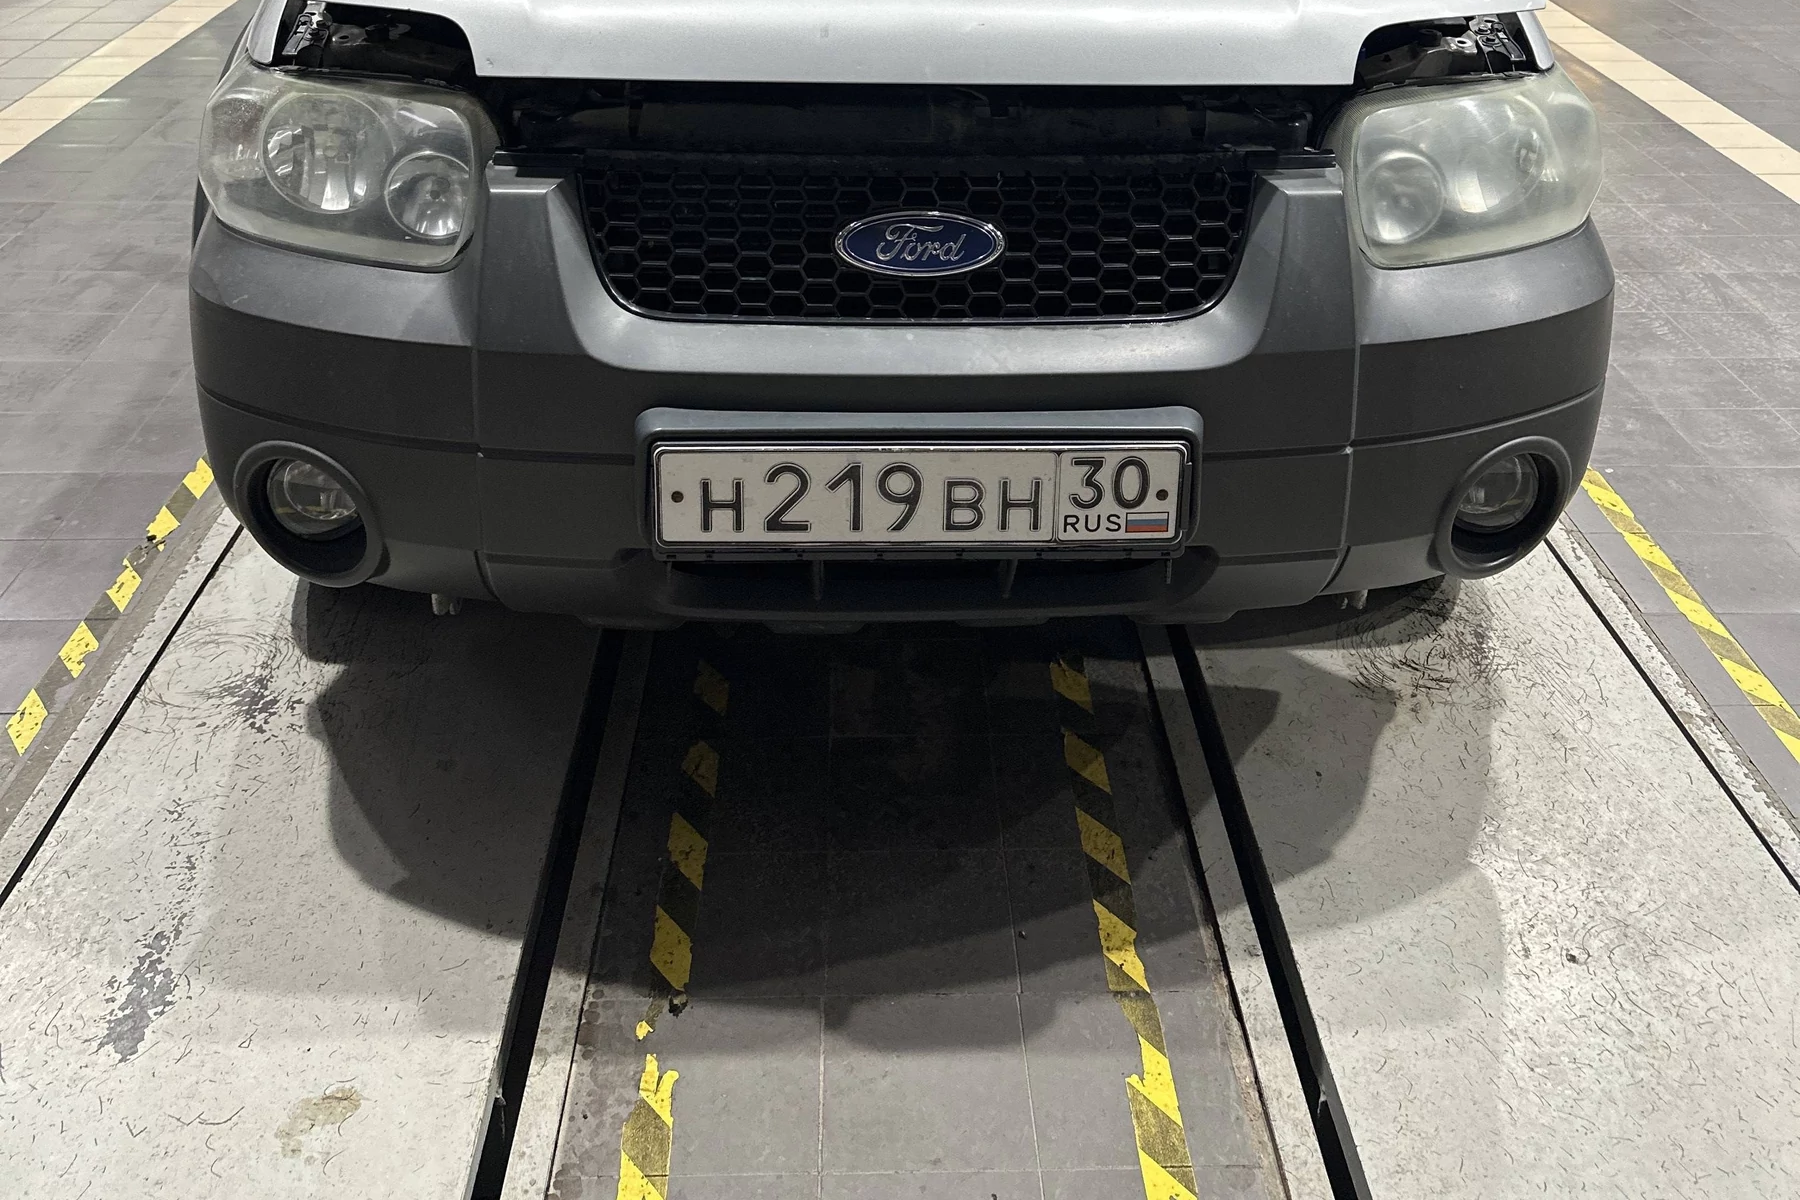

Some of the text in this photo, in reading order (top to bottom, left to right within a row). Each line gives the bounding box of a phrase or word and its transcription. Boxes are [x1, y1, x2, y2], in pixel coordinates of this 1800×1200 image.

[876, 224, 967, 261] Ford
[1068, 457, 1150, 510] 30
[1063, 514, 1121, 534] RUS
